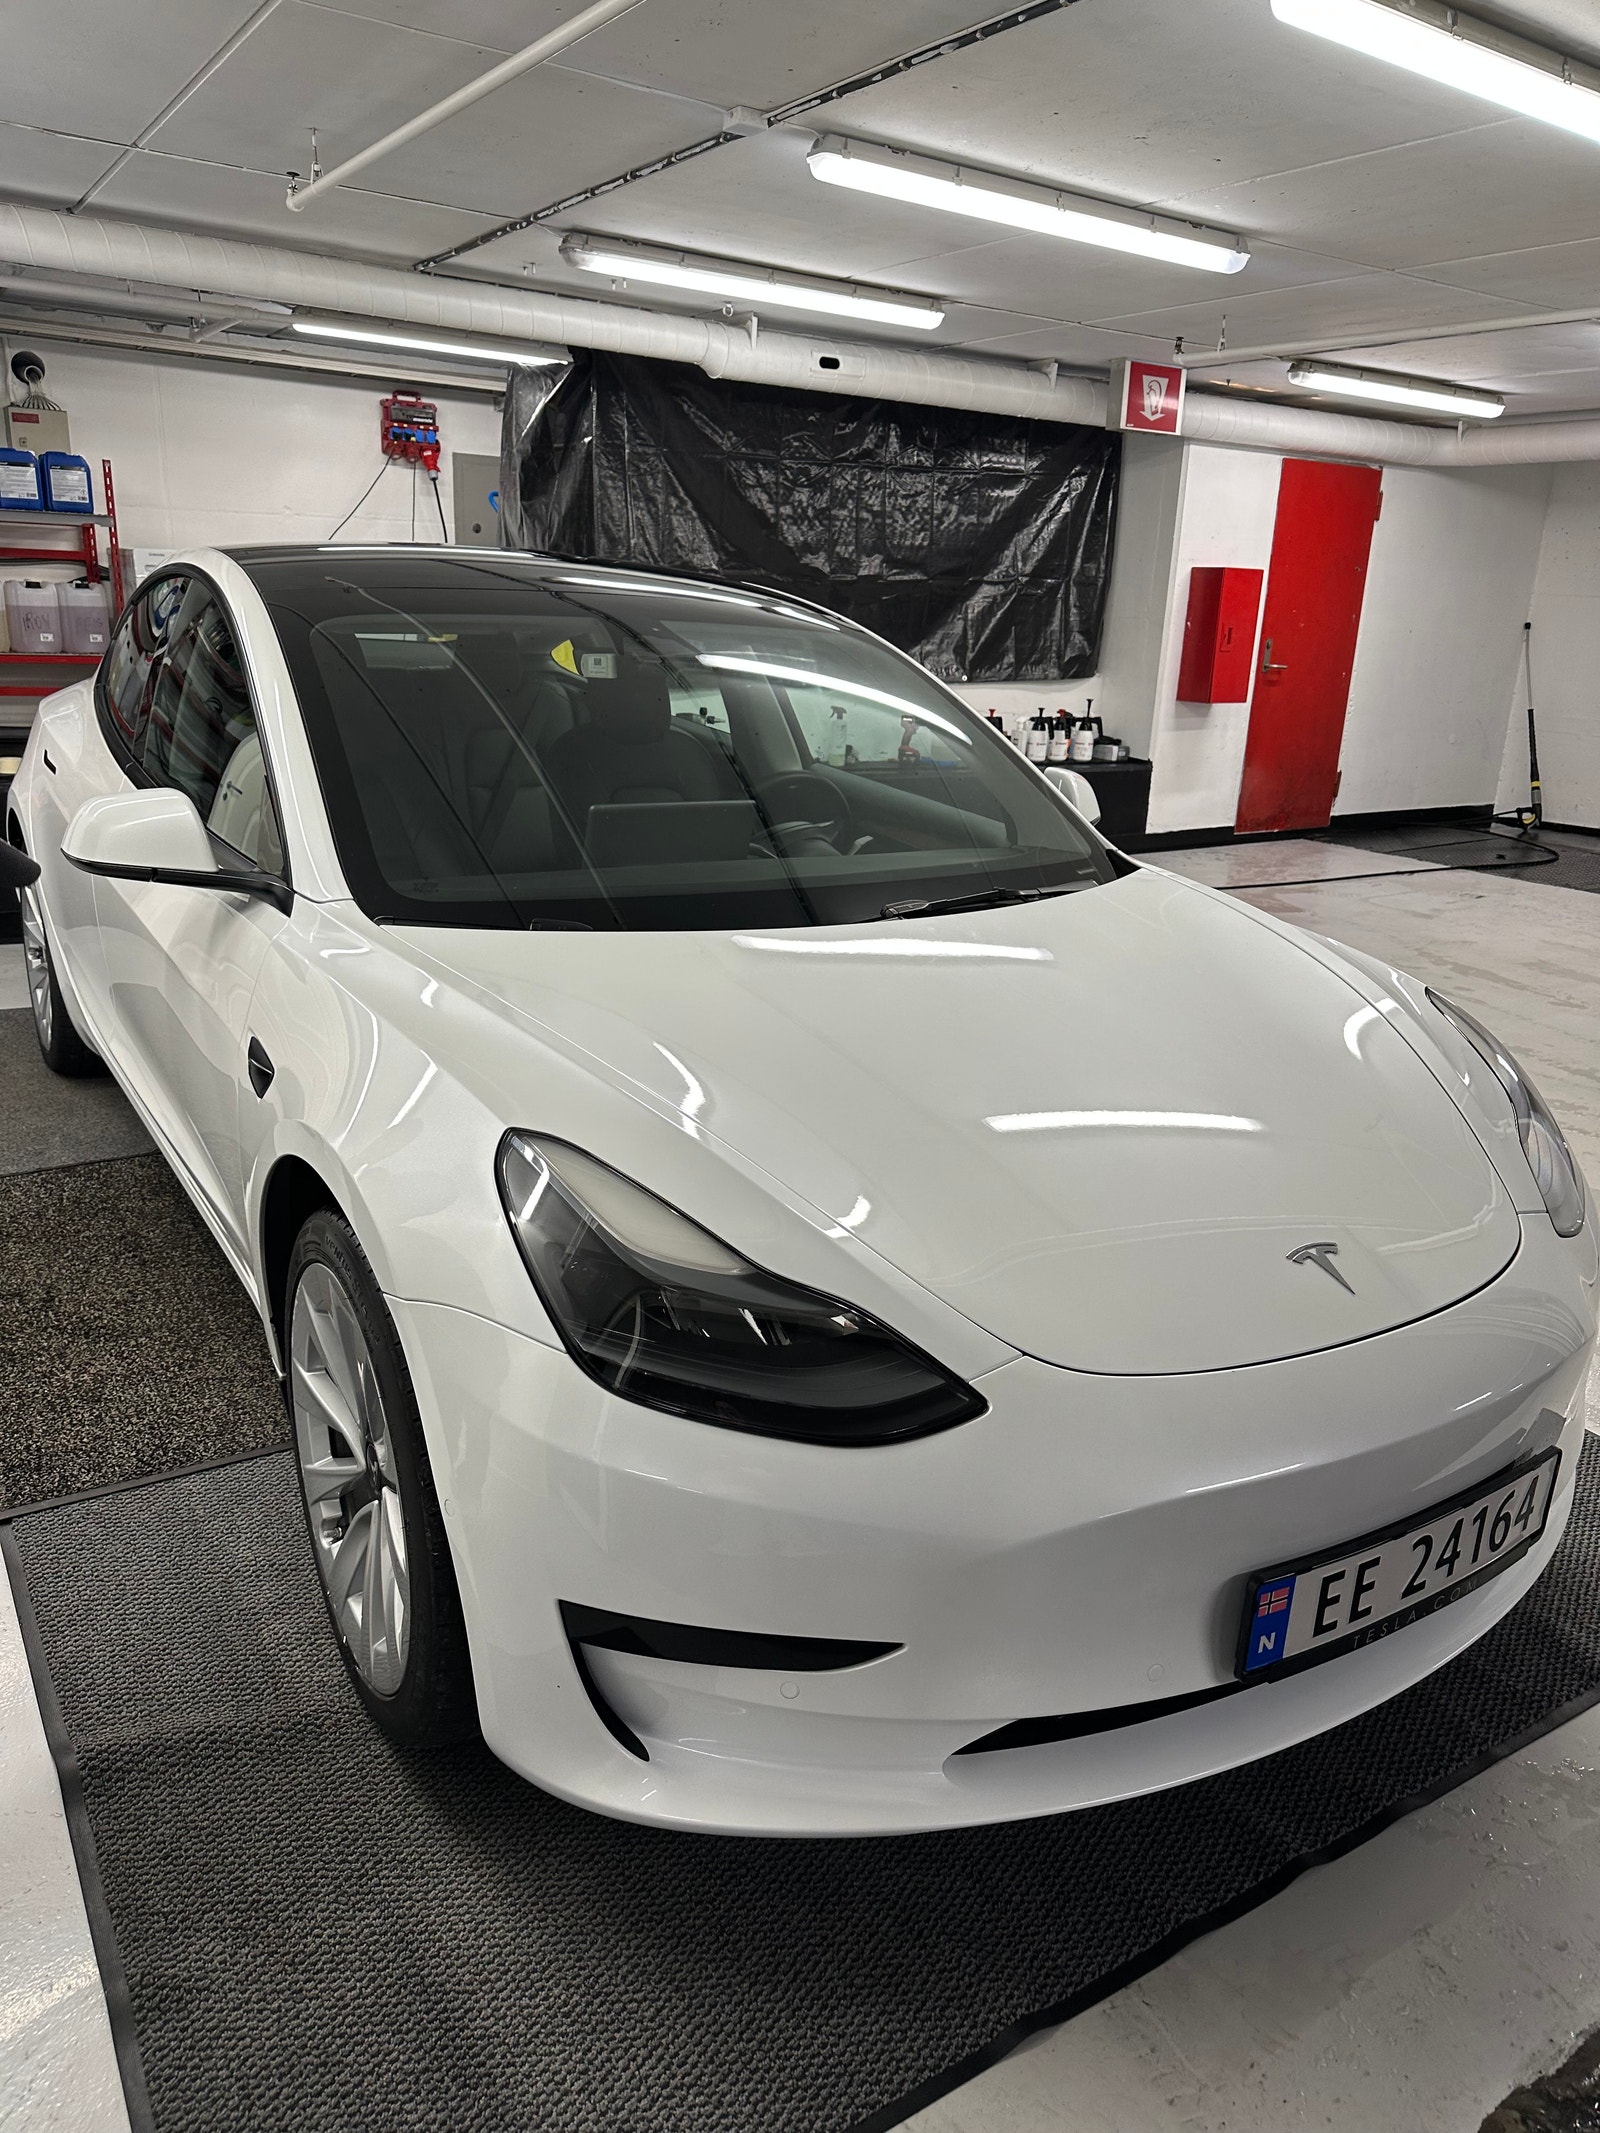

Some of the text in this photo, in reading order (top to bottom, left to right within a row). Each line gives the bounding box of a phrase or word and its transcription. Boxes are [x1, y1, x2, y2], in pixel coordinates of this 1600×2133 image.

[1312, 1475, 1540, 1638] EE 24164
[1257, 1632, 1276, 1654] N
[1352, 1578, 1478, 1649] TESLA.COM
